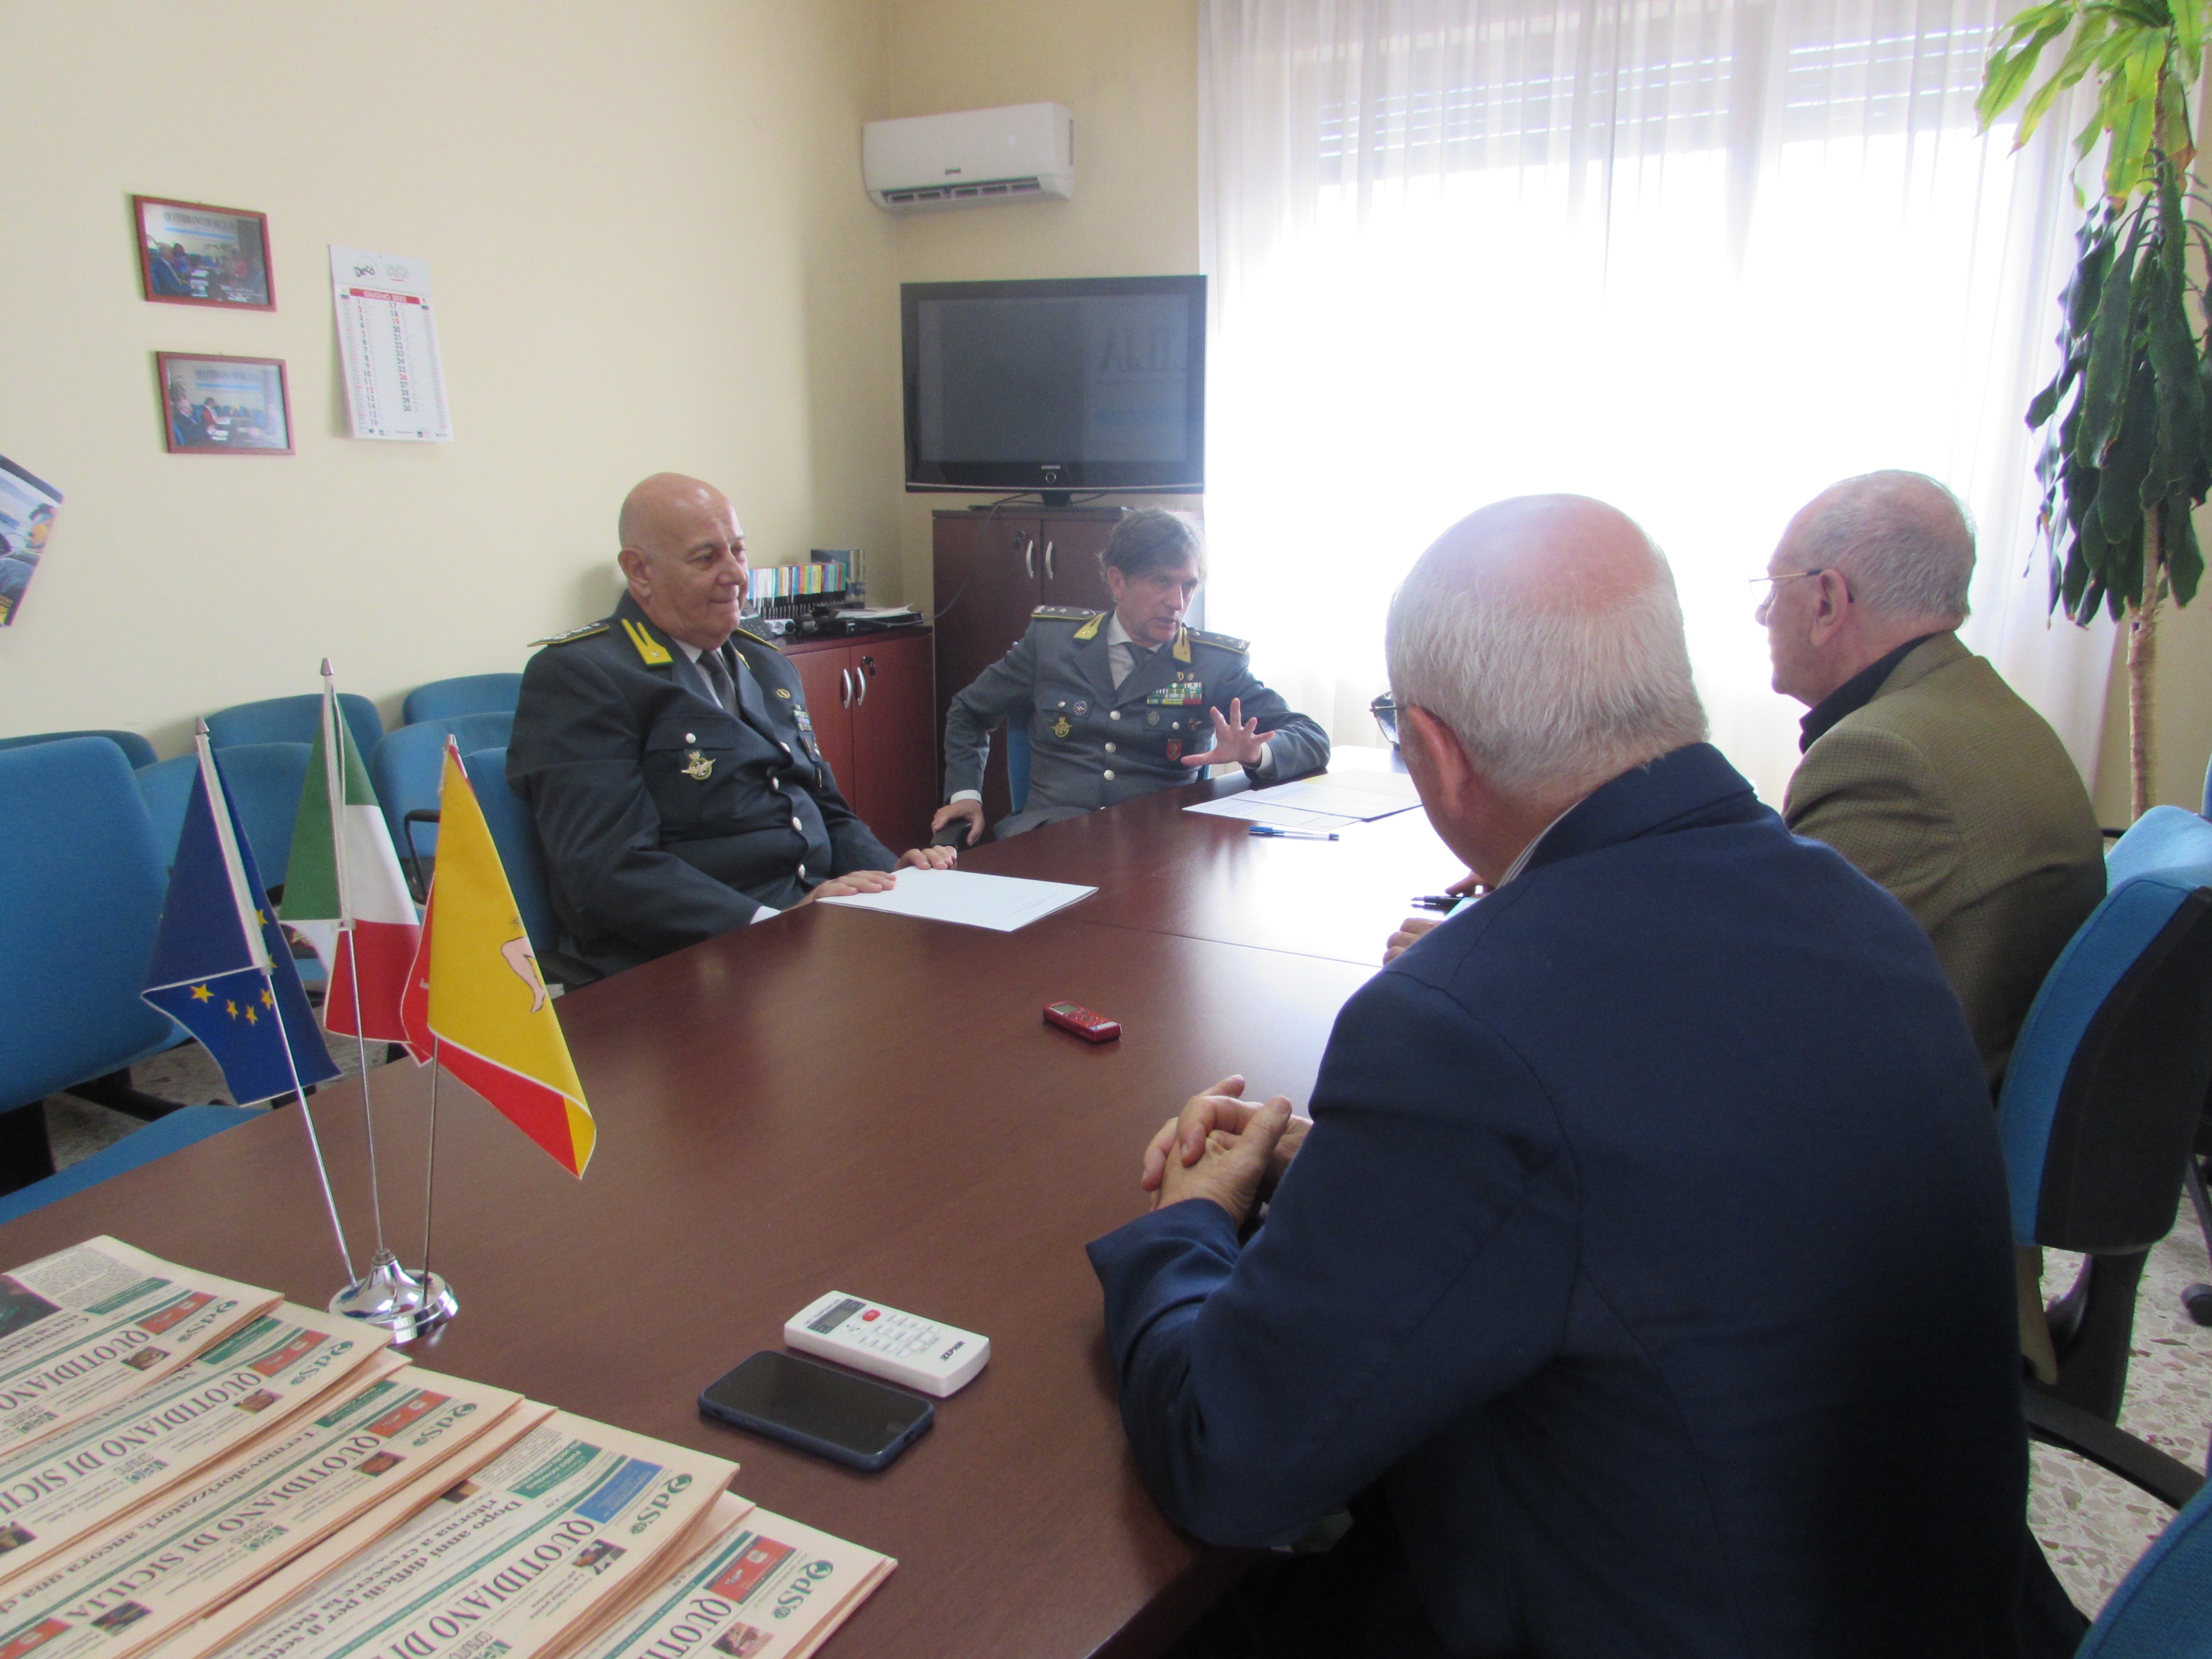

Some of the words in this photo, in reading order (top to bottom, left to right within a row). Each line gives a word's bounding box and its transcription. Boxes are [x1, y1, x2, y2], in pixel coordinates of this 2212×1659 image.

[0, 1332, 147, 1408] QUOTIDIANO
[102, 1375, 259, 1454] QUOTIDIANO
[63, 1451, 105, 1477] DI
[221, 1438, 378, 1531] QUOTIDIANO
[434, 1499, 497, 1537] ritorna
[474, 1500, 523, 1528] Dopo
[64, 1531, 139, 1572] ancora
[179, 1532, 220, 1553] DI
[419, 1538, 435, 1547] a
[428, 1530, 471, 1557] anni
[20, 1573, 65, 1598] una
[64, 1552, 185, 1616] SICILIA
[341, 1548, 420, 1597] crescere
[361, 1556, 427, 1598] difficili
[431, 1522, 591, 1635] QUOTIDIANO
[775, 1561, 832, 1609] QdS
[318, 1598, 344, 1610] la
[325, 1598, 362, 1624] per
[246, 1613, 321, 1656] fiducia
[306, 1624, 326, 1635] il
[388, 1630, 438, 1659] DI
